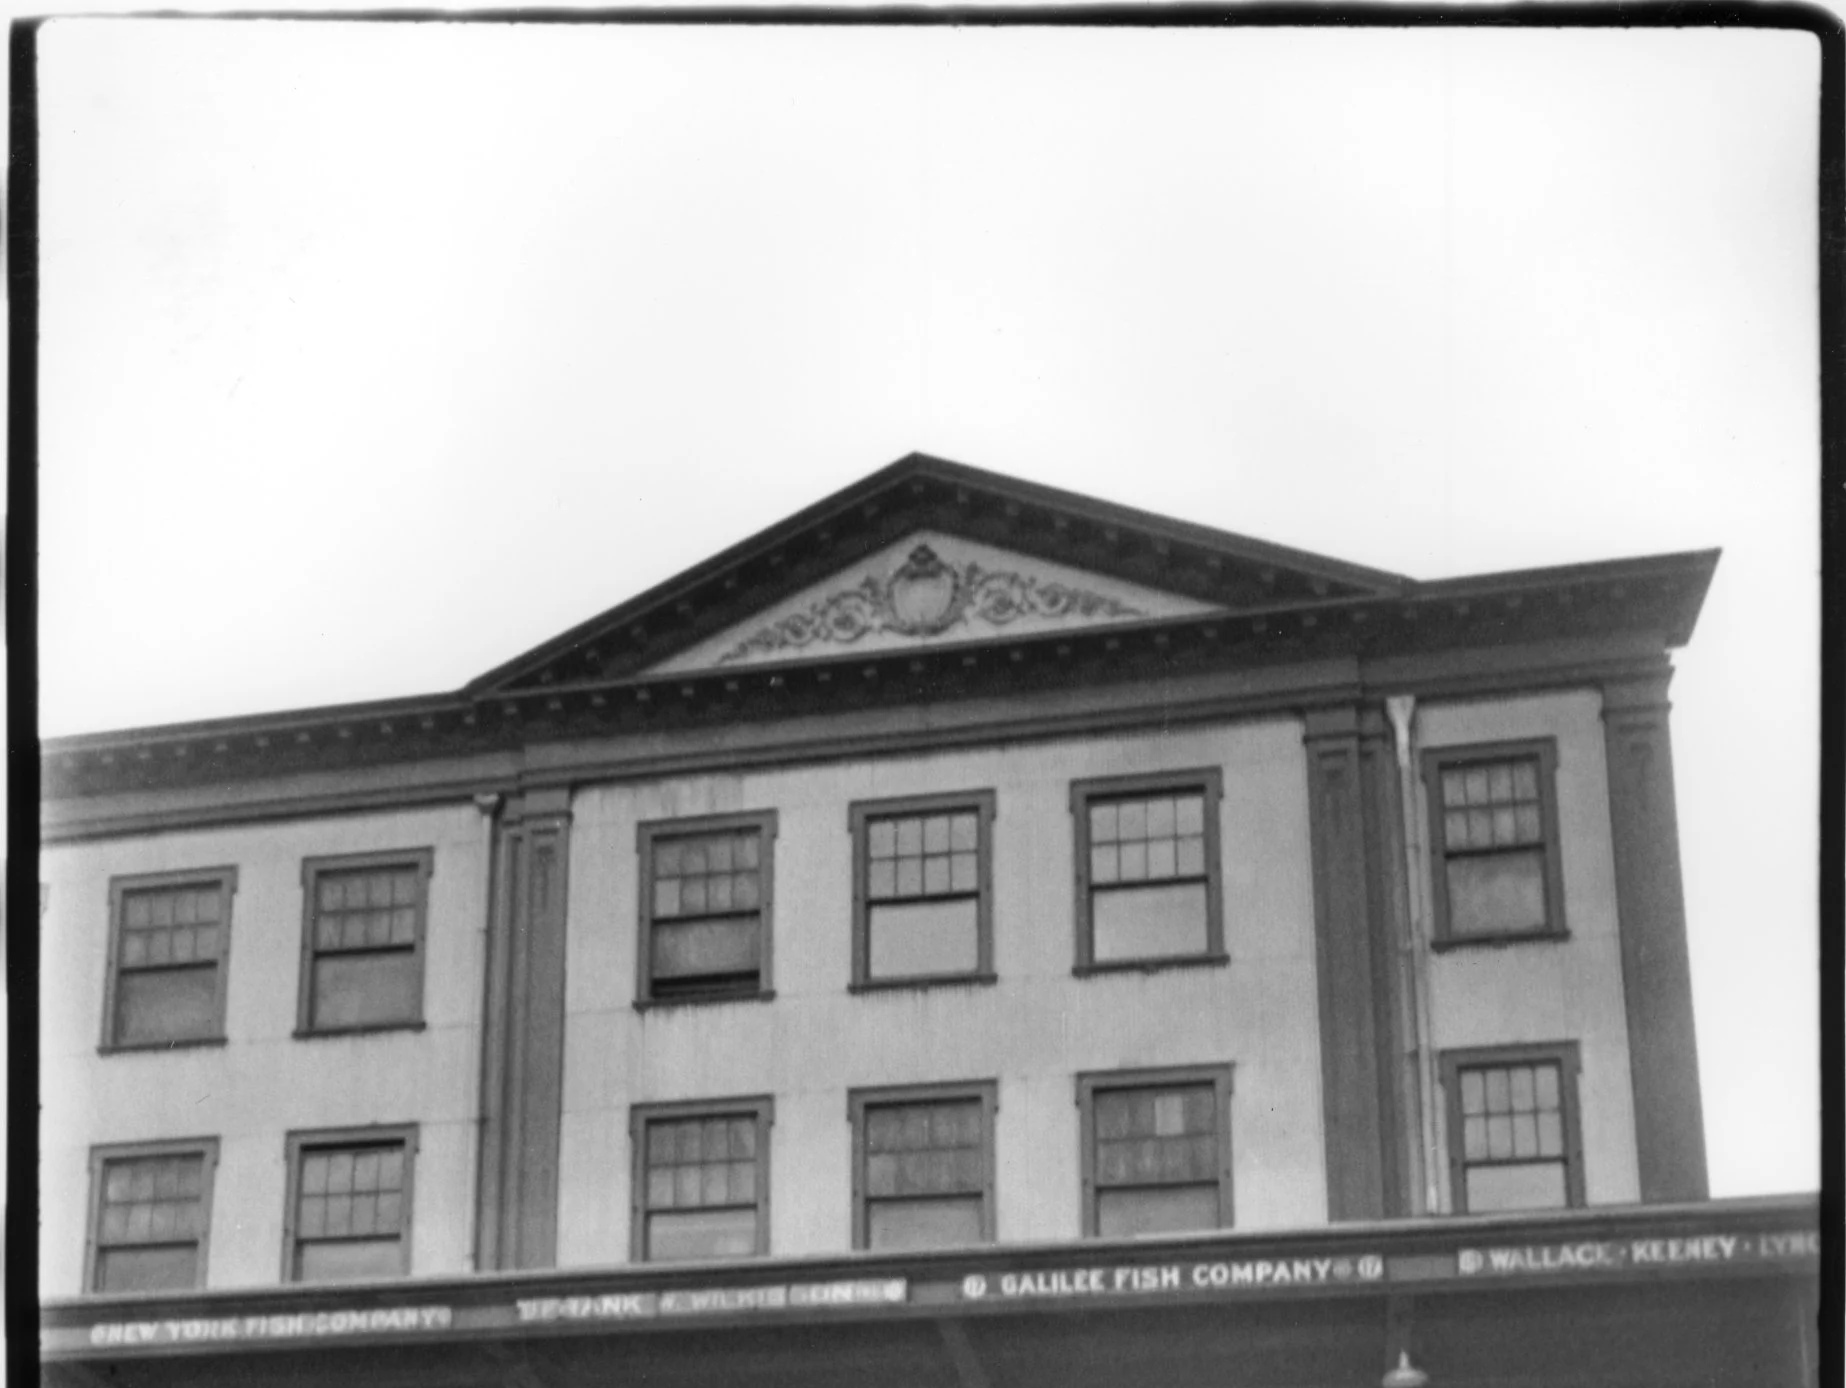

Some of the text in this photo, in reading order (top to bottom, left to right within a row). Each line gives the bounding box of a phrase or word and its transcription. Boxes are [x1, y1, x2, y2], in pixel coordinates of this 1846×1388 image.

[1631, 1235, 1738, 1264] KEENEY
[1000, 1268, 1105, 1297] GALILEE
[1114, 1265, 1180, 1291] FISH
[1192, 1257, 1332, 1287] COMPANY
[107, 1321, 160, 1344] NEW
[164, 1318, 237, 1341] YORK
[245, 1314, 303, 1338] FISH
[315, 1306, 438, 1334] COMPANY
